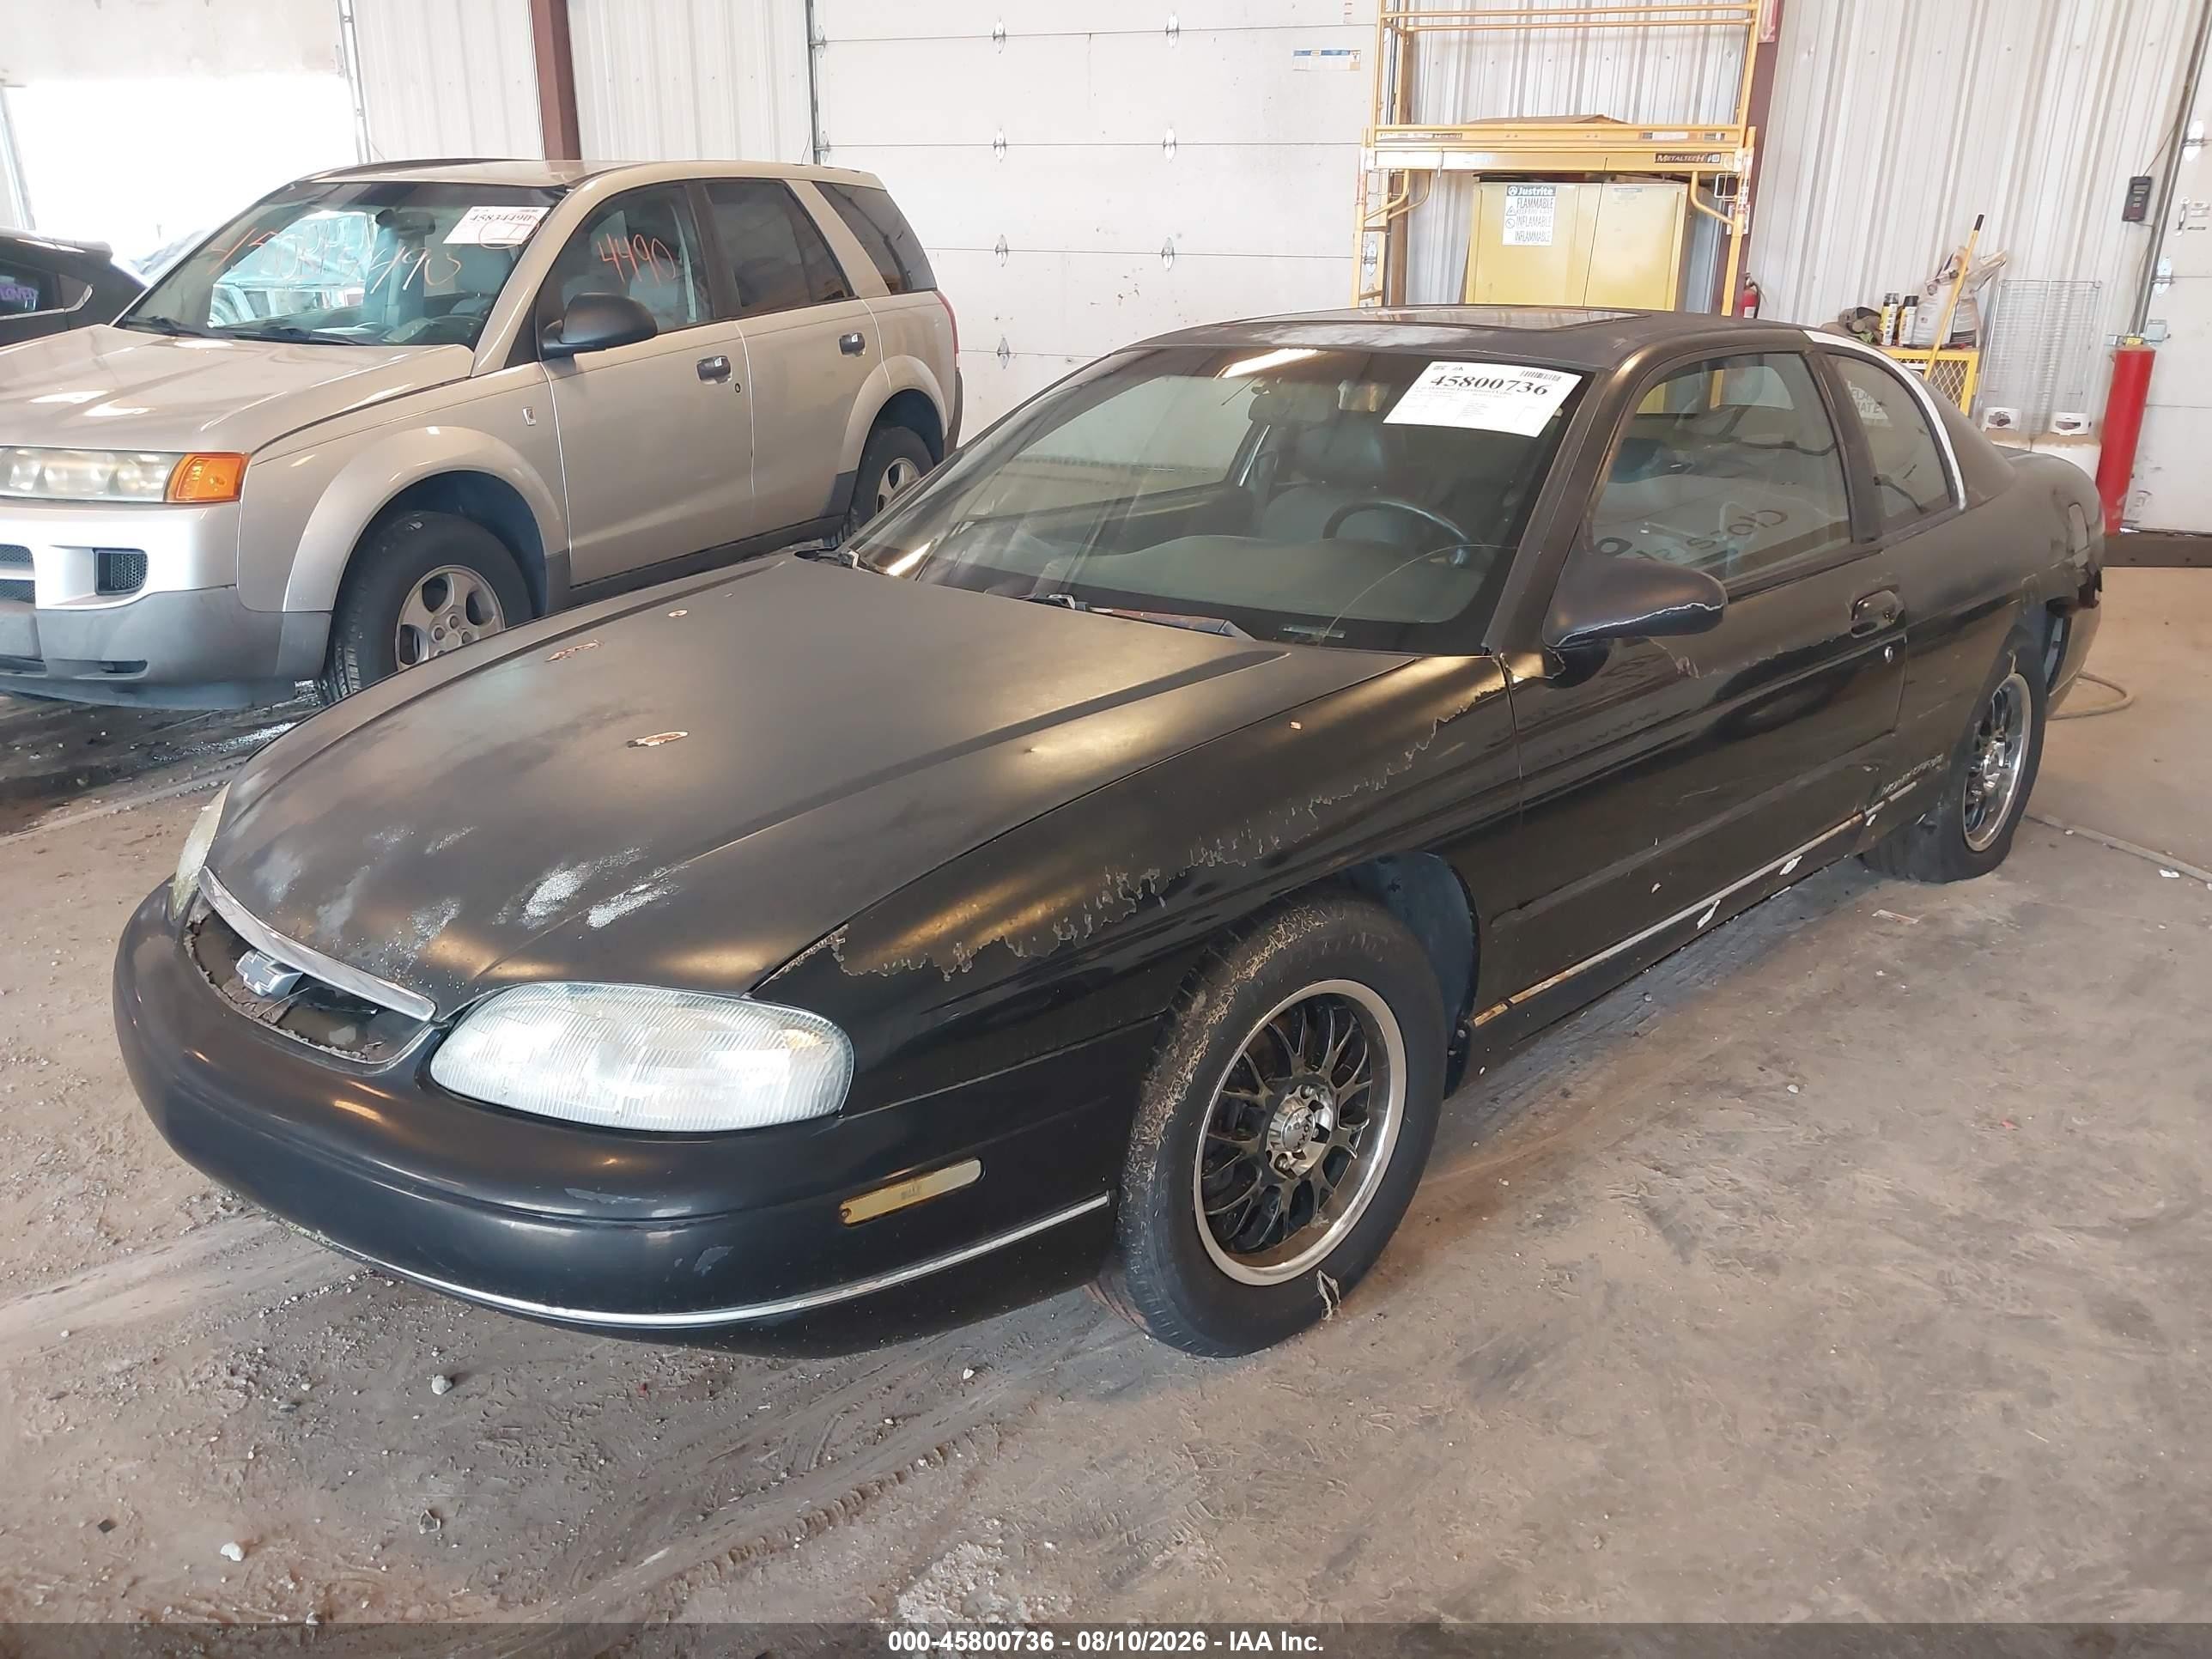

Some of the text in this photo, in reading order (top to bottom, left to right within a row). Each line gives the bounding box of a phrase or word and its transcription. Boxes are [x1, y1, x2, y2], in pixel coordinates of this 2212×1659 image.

[1518, 185, 1555, 196] Justrite
[1516, 197, 1554, 209] FLAMMABLE
[596, 232, 668, 287] 4490
[1430, 374, 1550, 396] 45800736
